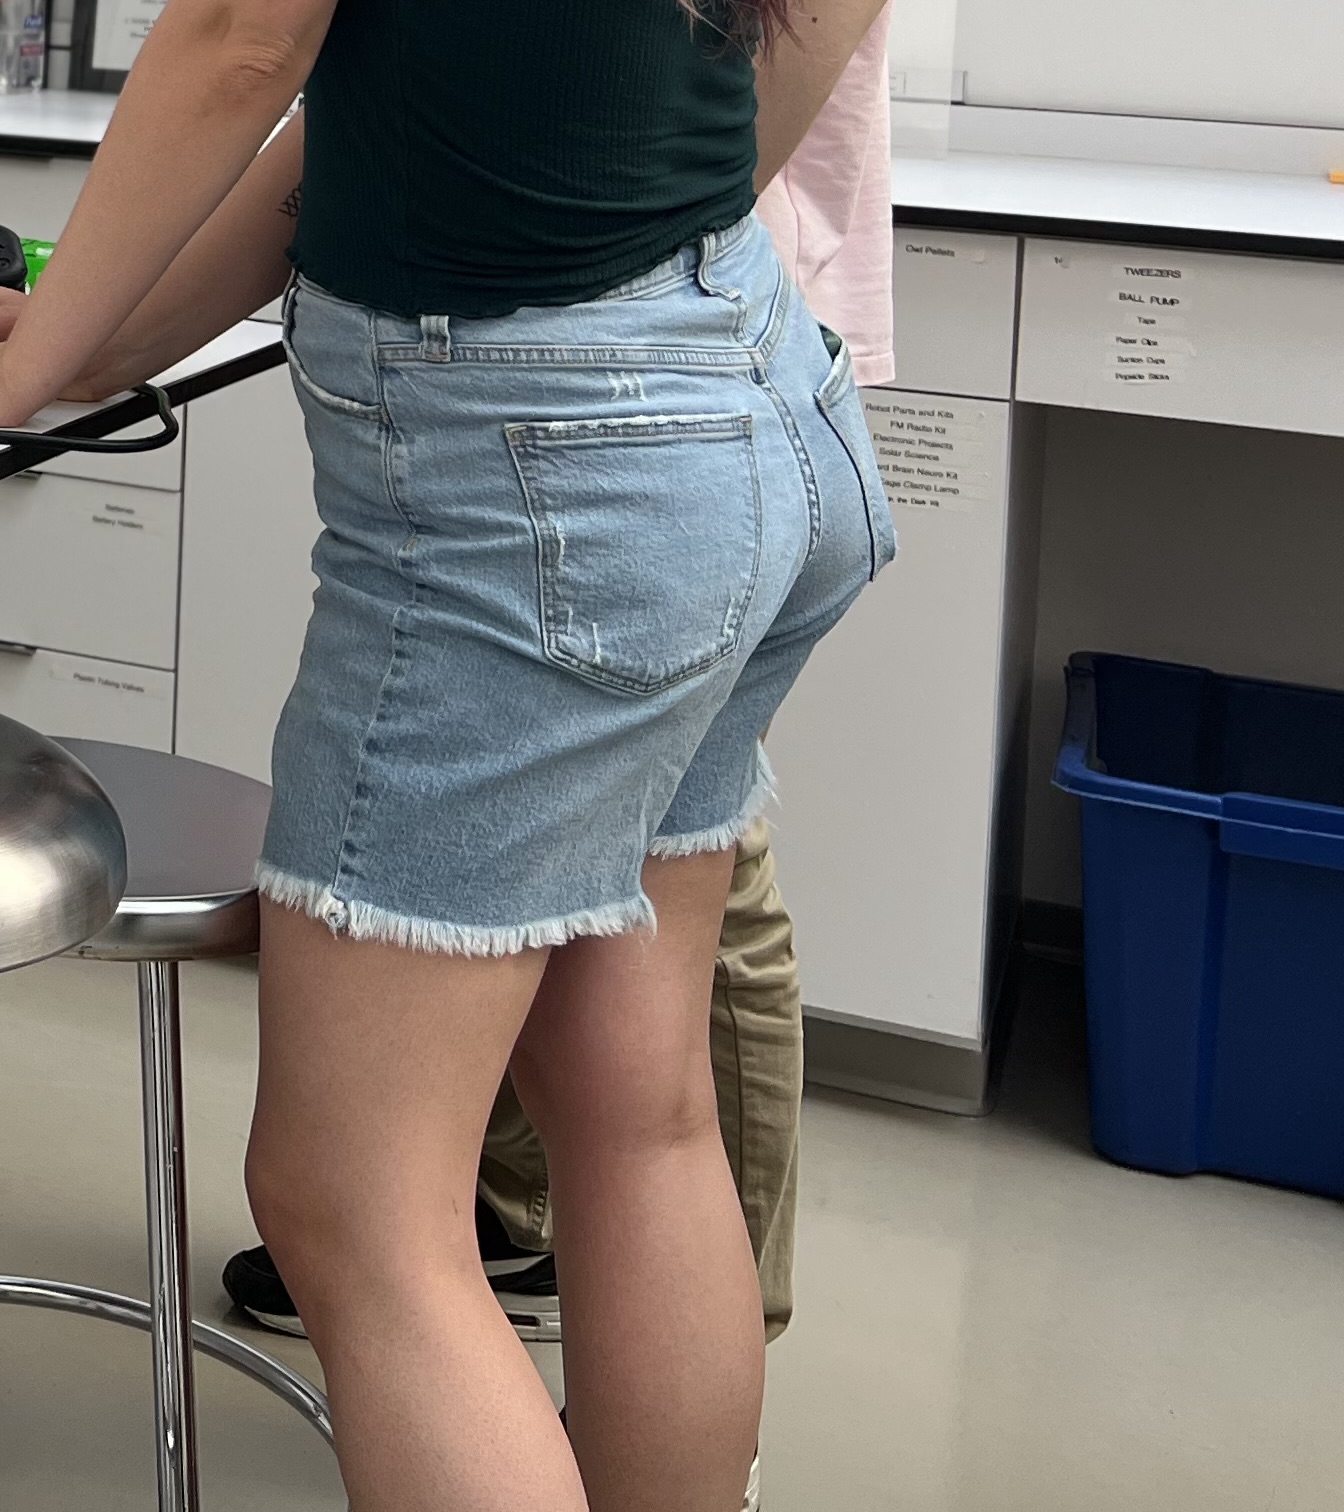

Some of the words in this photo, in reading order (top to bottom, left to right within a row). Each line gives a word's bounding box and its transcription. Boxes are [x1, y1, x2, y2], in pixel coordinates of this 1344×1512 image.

[905, 244, 924, 254] Owl
[925, 245, 955, 258] Pellets
[1123, 267, 1182, 279] TWEEZERS
[1118, 292, 1145, 304] BALL
[1149, 295, 1180, 306] PUMP
[1137, 316, 1157, 325] Tape
[1115, 336, 1137, 345] Paper
[865, 402, 891, 413] Robot
[892, 405, 916, 416] Parts
[918, 409, 935, 417] and
[937, 410, 954, 419] Kits
[889, 420, 904, 429] FM
[906, 422, 933, 433] Radio
[934, 426, 946, 435] Kit
[872, 432, 916, 446] Electronic
[918, 438, 954, 451] Projects
[878, 447, 902, 457] Solar
[903, 449, 940, 462] Science
[892, 464, 914, 475] Brain
[916, 467, 944, 478] Neuro
[946, 471, 958, 480] Kit
[903, 480, 932, 492] Clamp
[933, 484, 960, 495] Lamp
